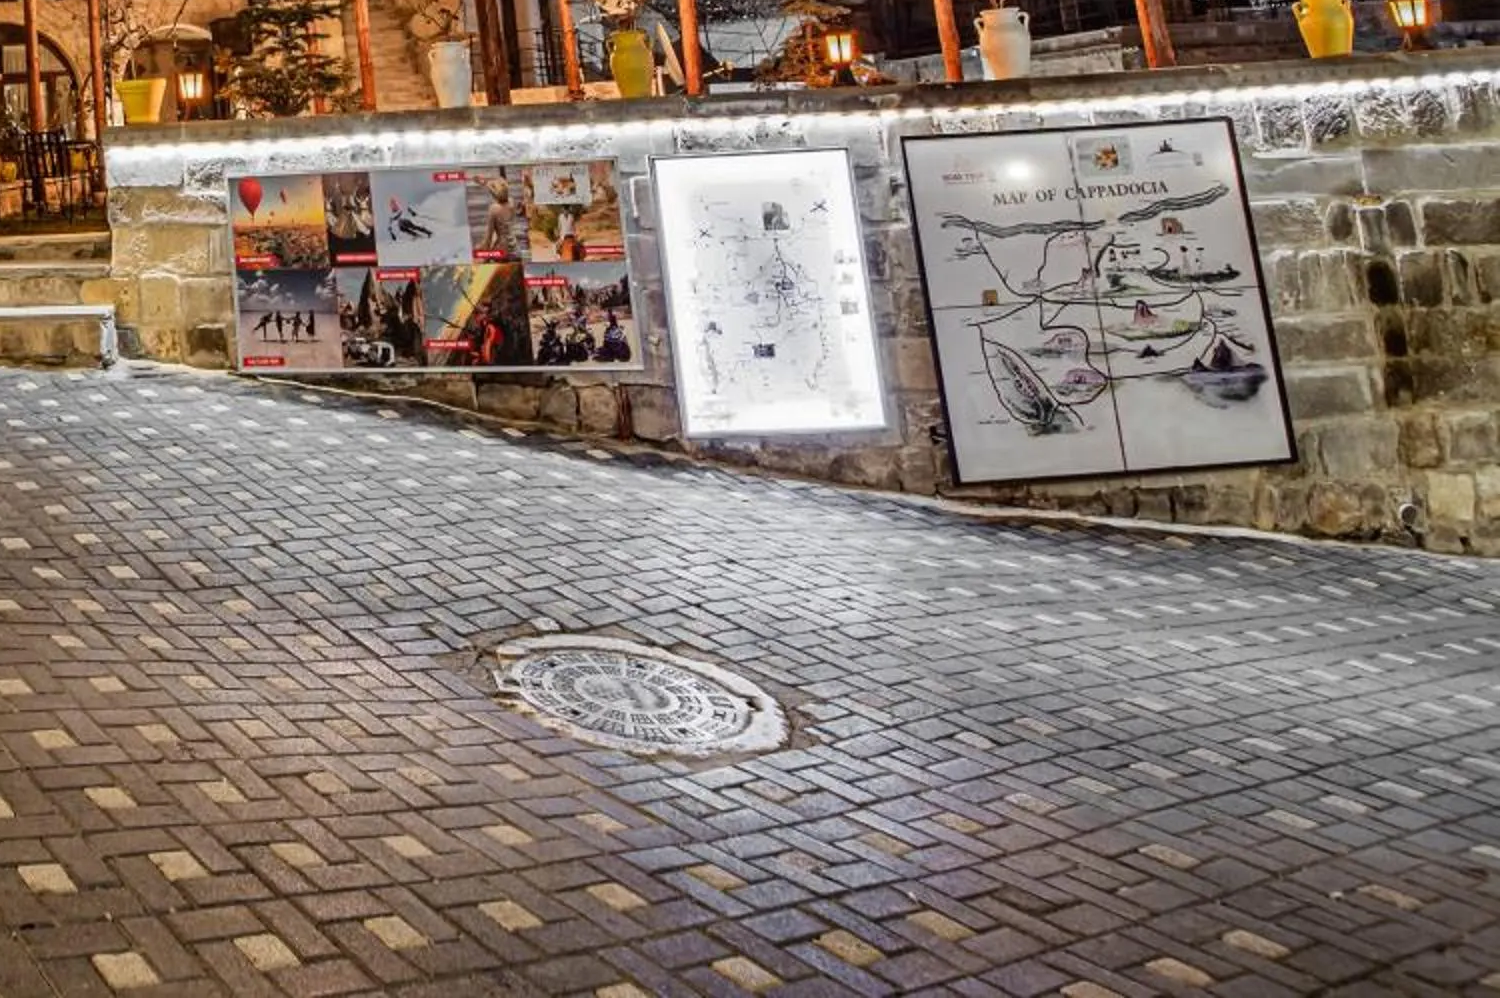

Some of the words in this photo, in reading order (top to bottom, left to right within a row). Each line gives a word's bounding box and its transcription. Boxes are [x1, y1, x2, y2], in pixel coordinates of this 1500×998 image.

[993, 191, 1027, 206] MAP
[1035, 189, 1055, 202] OF
[1065, 181, 1169, 200] CAPPADOCIA
